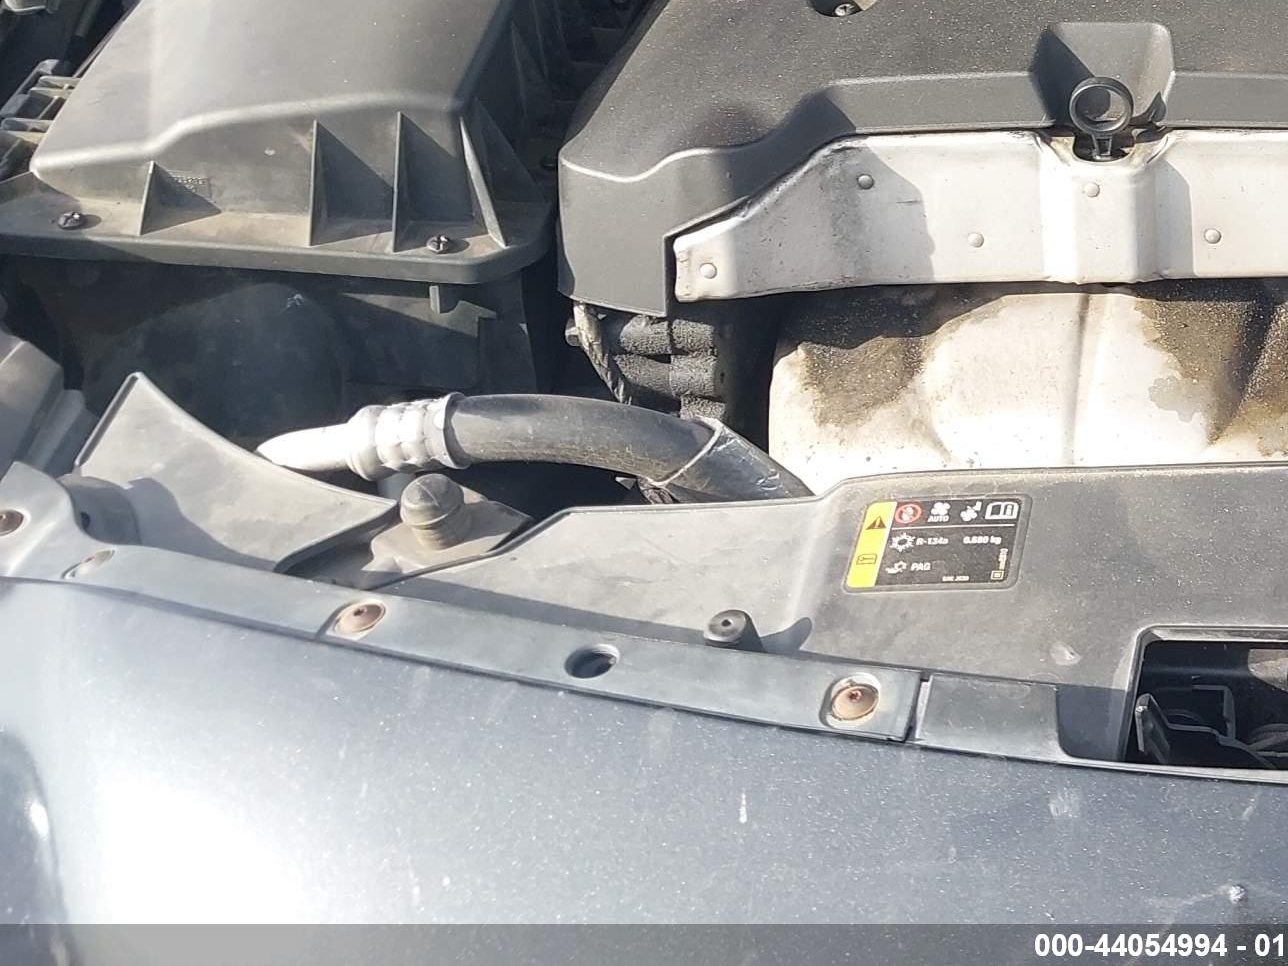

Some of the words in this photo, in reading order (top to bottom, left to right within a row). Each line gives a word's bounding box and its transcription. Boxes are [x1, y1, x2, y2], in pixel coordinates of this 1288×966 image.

[927, 515, 950, 523] AUTO
[915, 537, 949, 545] R-134a
[990, 536, 1002, 545] kg
[911, 562, 931, 571] PAG
